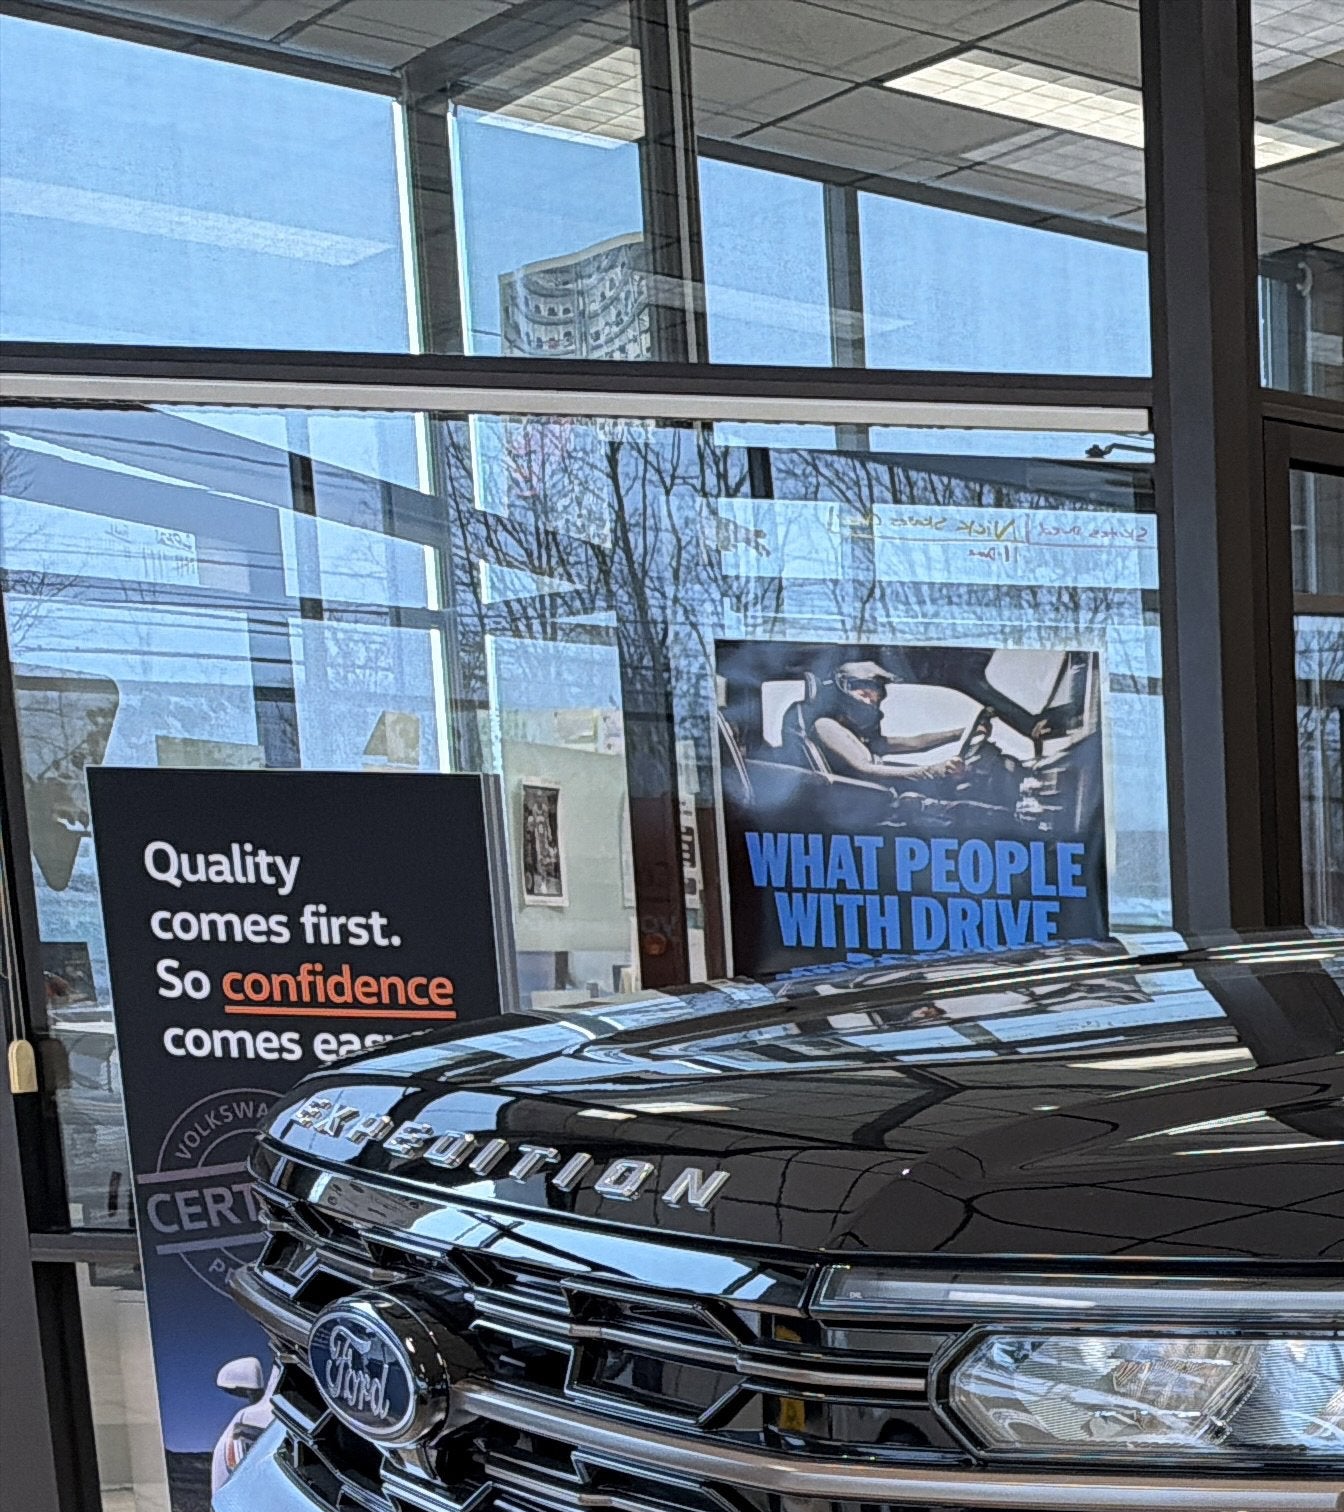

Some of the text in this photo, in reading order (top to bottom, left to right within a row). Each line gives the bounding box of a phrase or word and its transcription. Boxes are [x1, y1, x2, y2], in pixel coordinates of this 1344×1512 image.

[144, 840, 300, 896] Quality
[745, 832, 884, 891] WHAT
[895, 836, 1087, 897] PEOPLE
[150, 903, 401, 947] comes first.
[774, 891, 1061, 951] WITH DRIVE
[156, 958, 455, 1006] So confidence
[163, 1026, 302, 1061] comes
[296, 1098, 731, 1212] EXPEDITION
[326, 1325, 390, 1419] Ford
